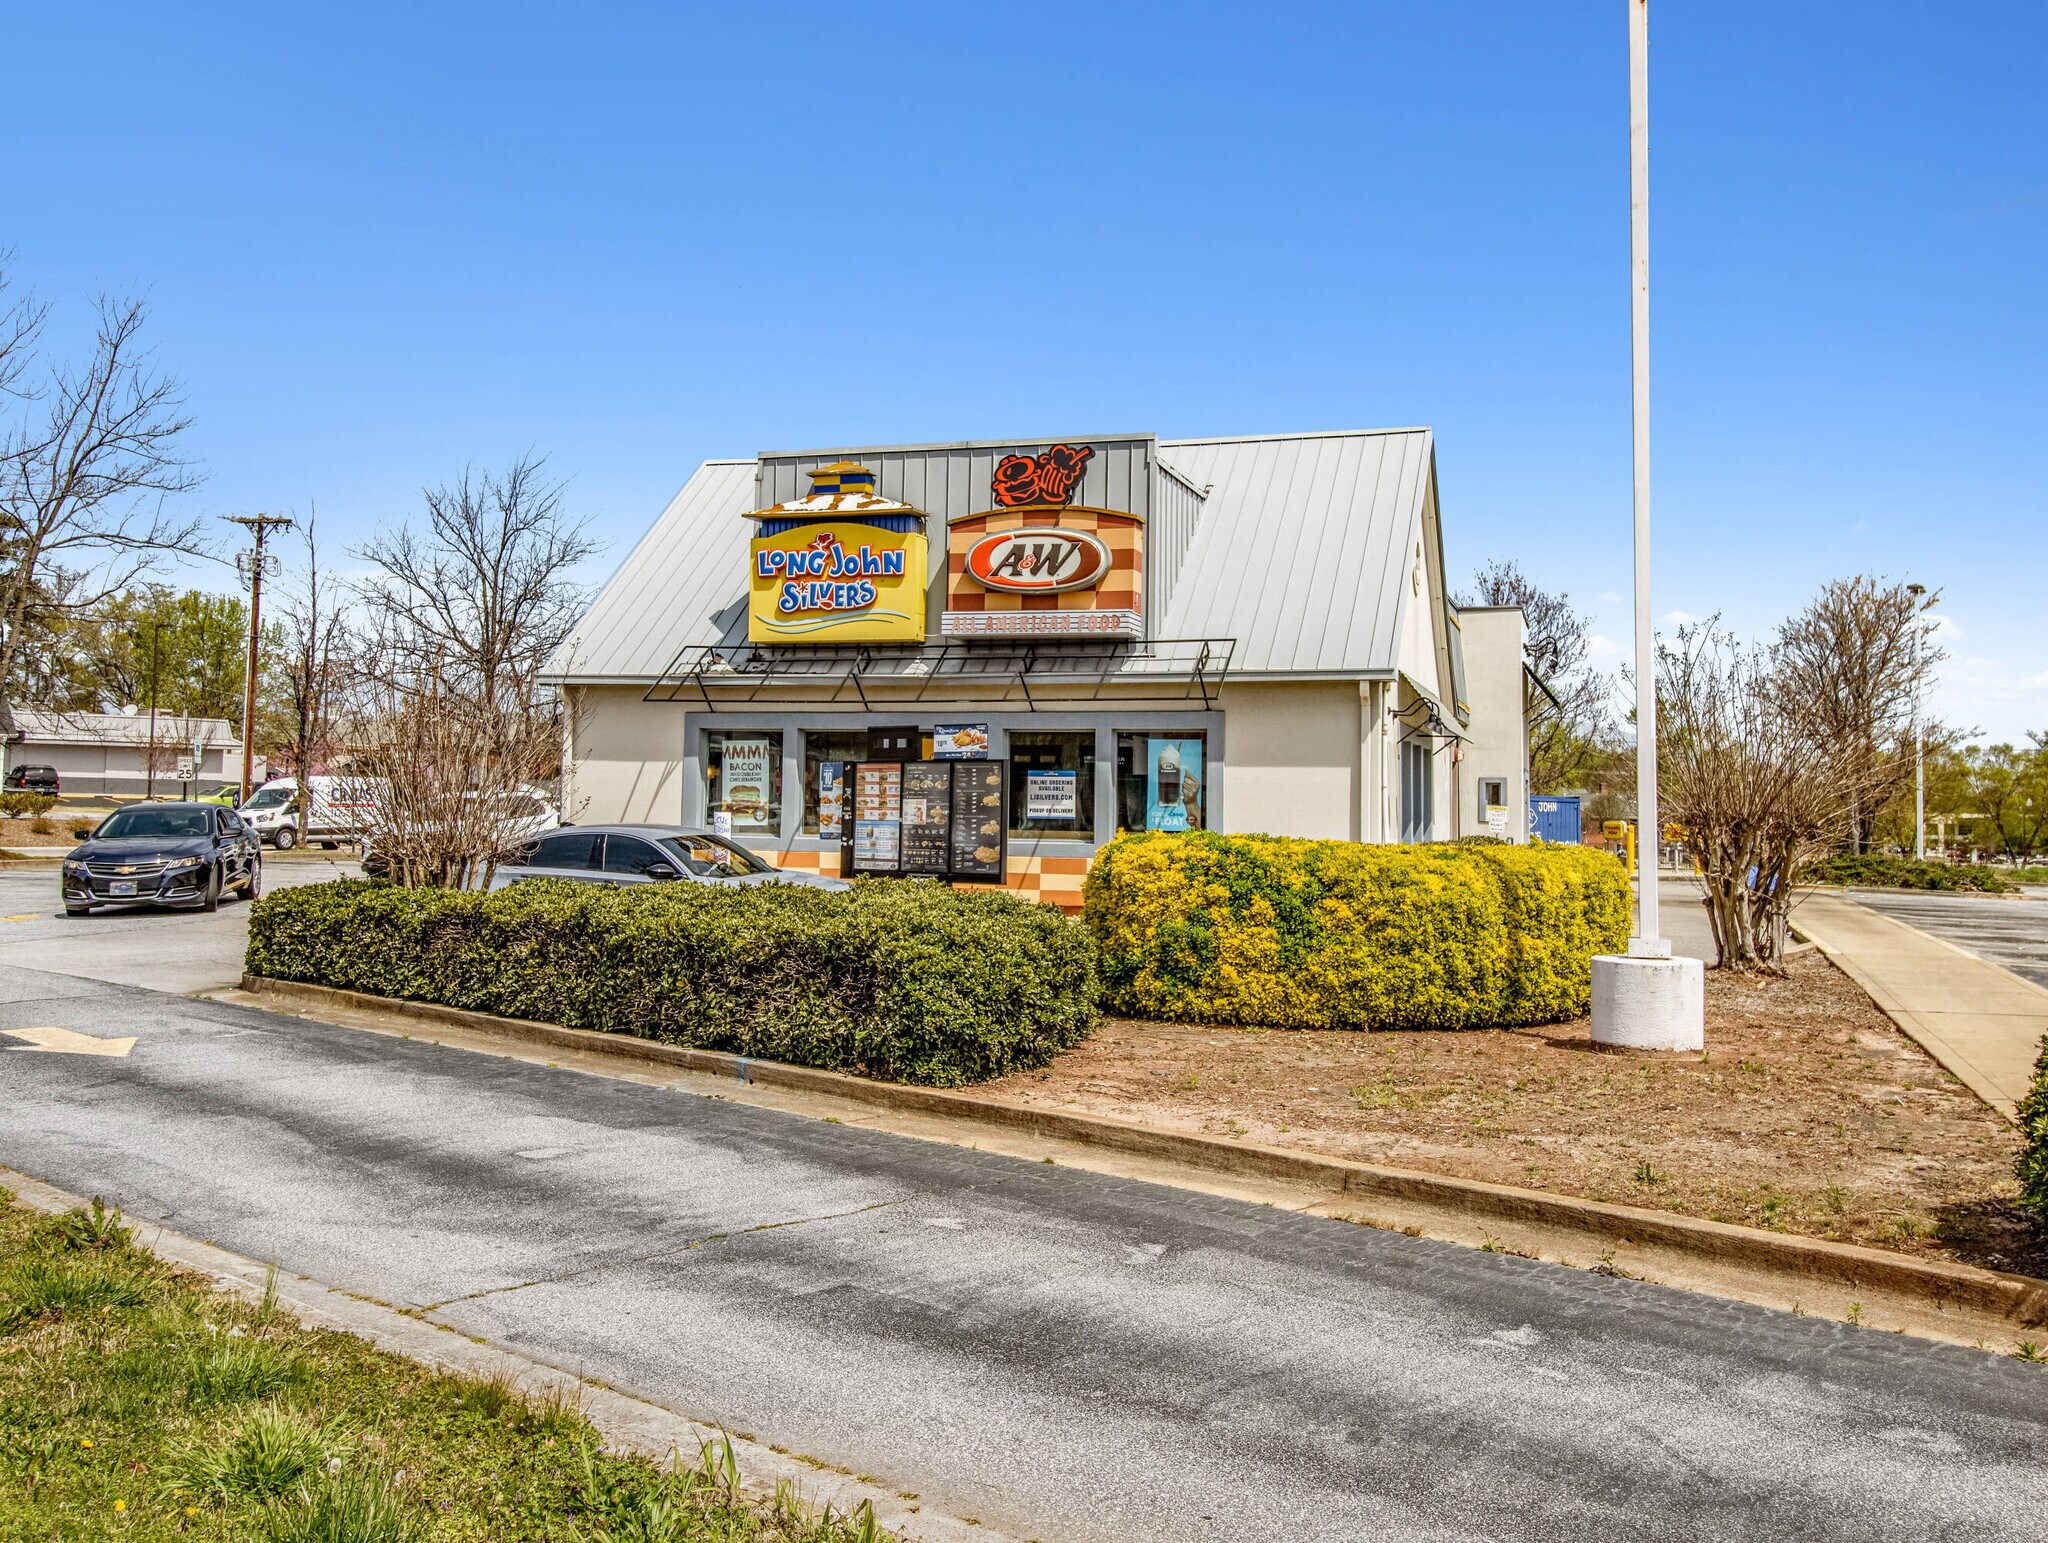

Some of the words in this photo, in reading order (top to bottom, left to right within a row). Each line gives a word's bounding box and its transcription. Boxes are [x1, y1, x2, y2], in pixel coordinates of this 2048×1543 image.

[986, 542, 1082, 578] A&W
[951, 616, 977, 634] ALL
[984, 614, 1071, 633] AMERICAN
[1077, 613, 1121, 632] FOOD
[729, 762, 762, 771] BACON
[178, 769, 192, 779] 25
[1538, 802, 1558, 812] JOHN
[1155, 817, 1184, 826] FLOAT
